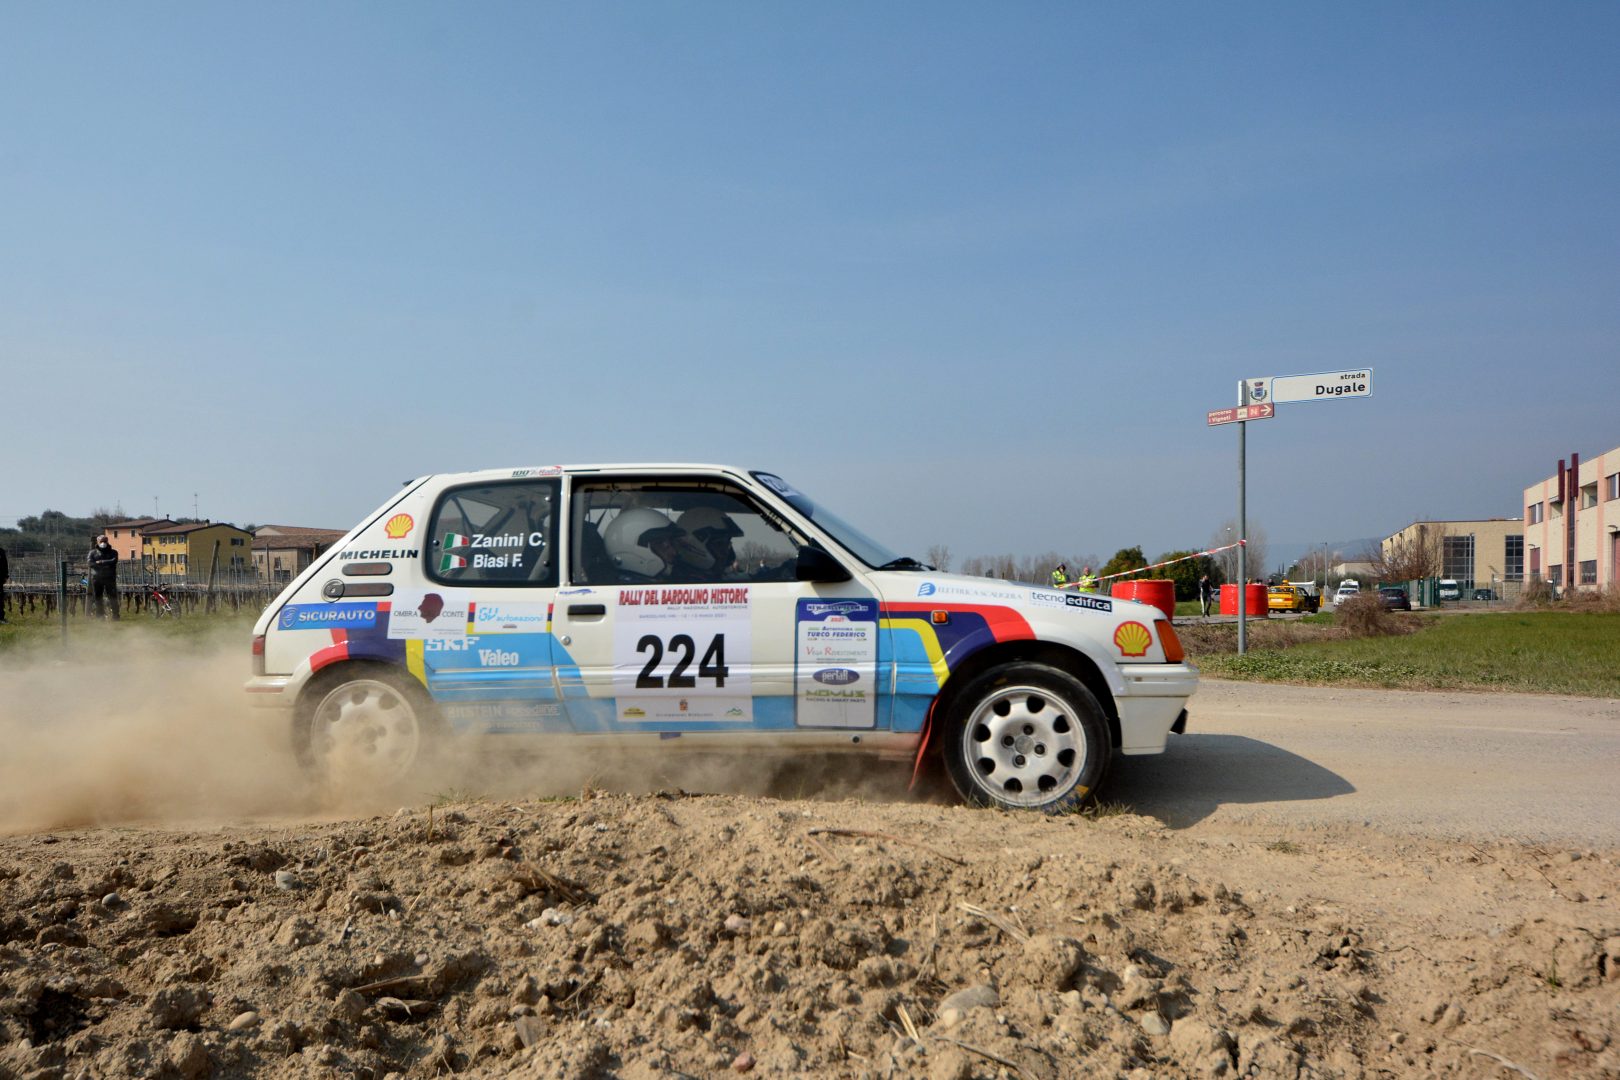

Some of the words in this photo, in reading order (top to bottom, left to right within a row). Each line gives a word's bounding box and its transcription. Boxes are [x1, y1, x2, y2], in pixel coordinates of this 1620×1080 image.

[1340, 372, 1366, 380] strada
[1316, 382, 1366, 396] Dugale
[471, 533, 524, 548] Zanini
[528, 532, 546, 547] C.
[340, 549, 419, 560] MICHELIN
[473, 553, 509, 568] Biasi
[512, 553, 523, 568] F.
[618, 590, 643, 606] RALLY
[644, 590, 659, 605] DEL
[661, 589, 709, 605] BARDOLINO
[710, 588, 749, 604] HISTORIC
[298, 610, 376, 623] SICURAUTO
[393, 610, 419, 618] OMBRA
[478, 649, 519, 667] Valeo
[636, 633, 729, 688] 224
